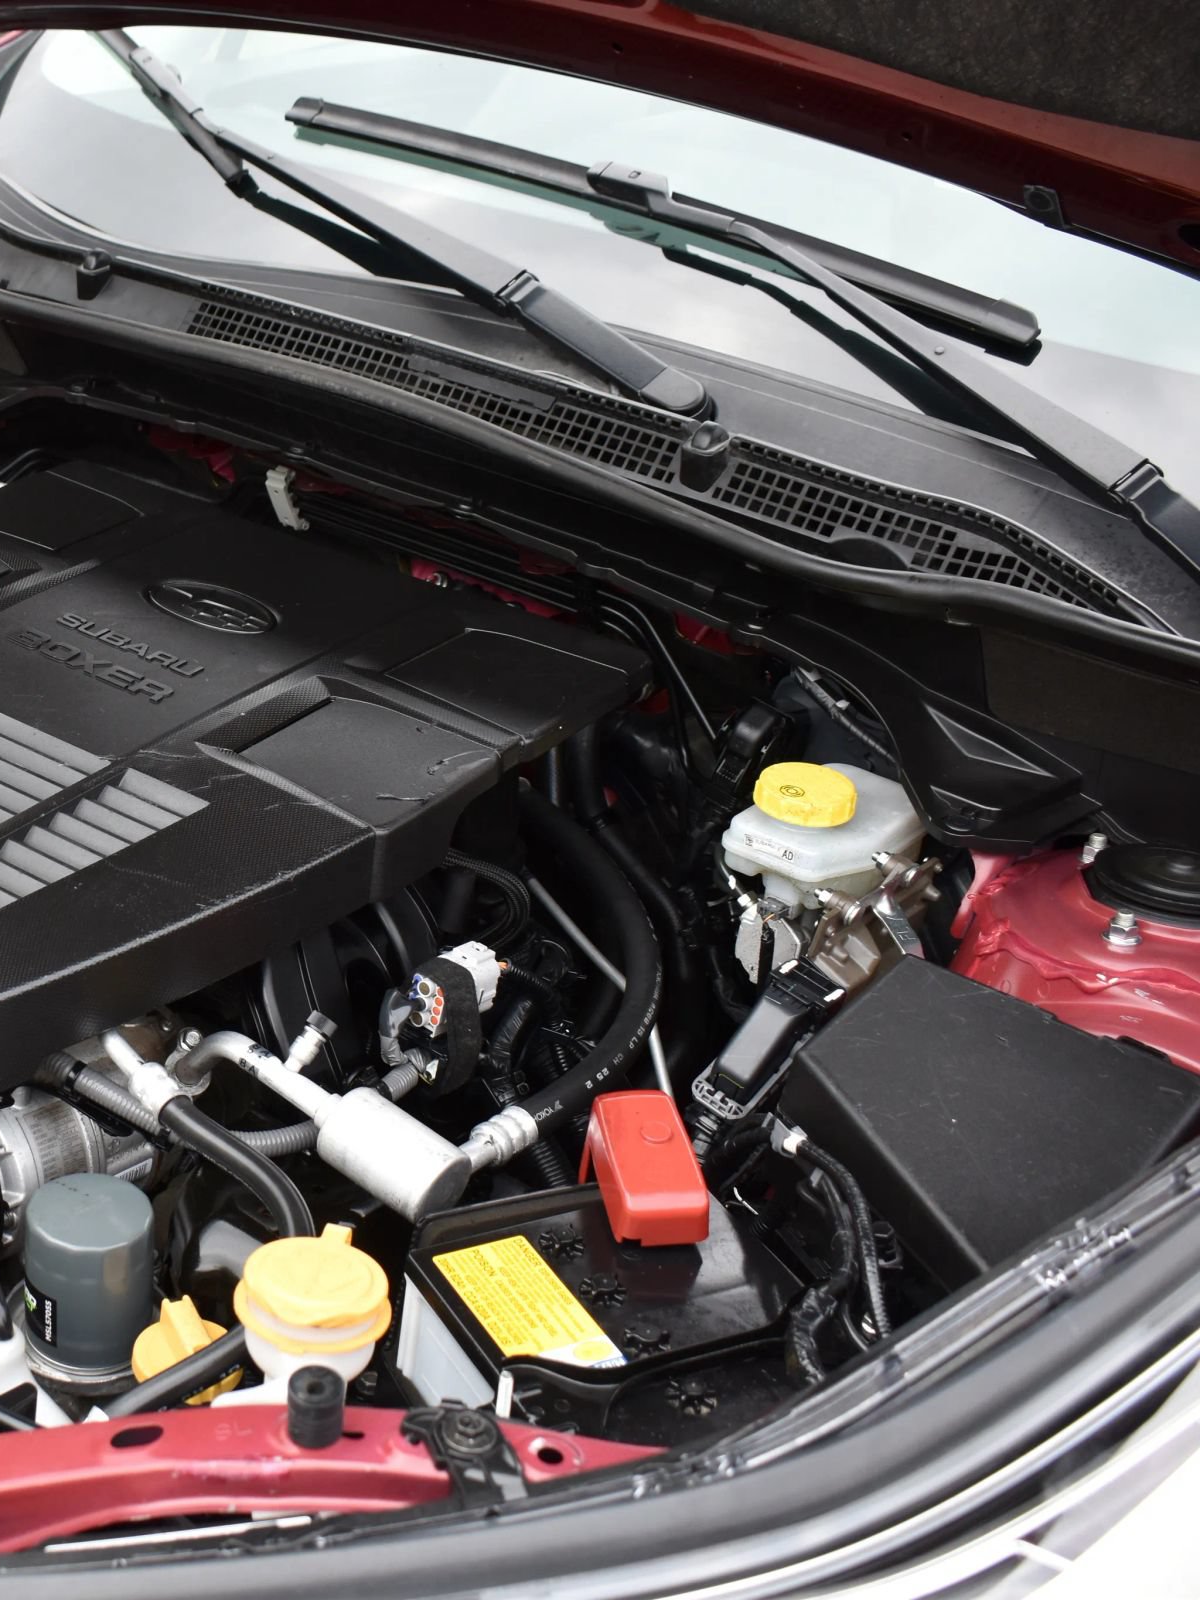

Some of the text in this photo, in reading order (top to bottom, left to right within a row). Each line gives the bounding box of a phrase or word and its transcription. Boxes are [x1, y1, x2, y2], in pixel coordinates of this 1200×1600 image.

[56, 612, 205, 678] SUBARU
[7, 628, 176, 704] BOXER
[781, 850, 794, 861] AD
[628, 1037, 639, 1049] LP
[584, 1080, 594, 1089] 2
[596, 1067, 610, 1081] 25
[472, 1248, 496, 1277] POISON
[512, 1238, 542, 1267] DANGER
